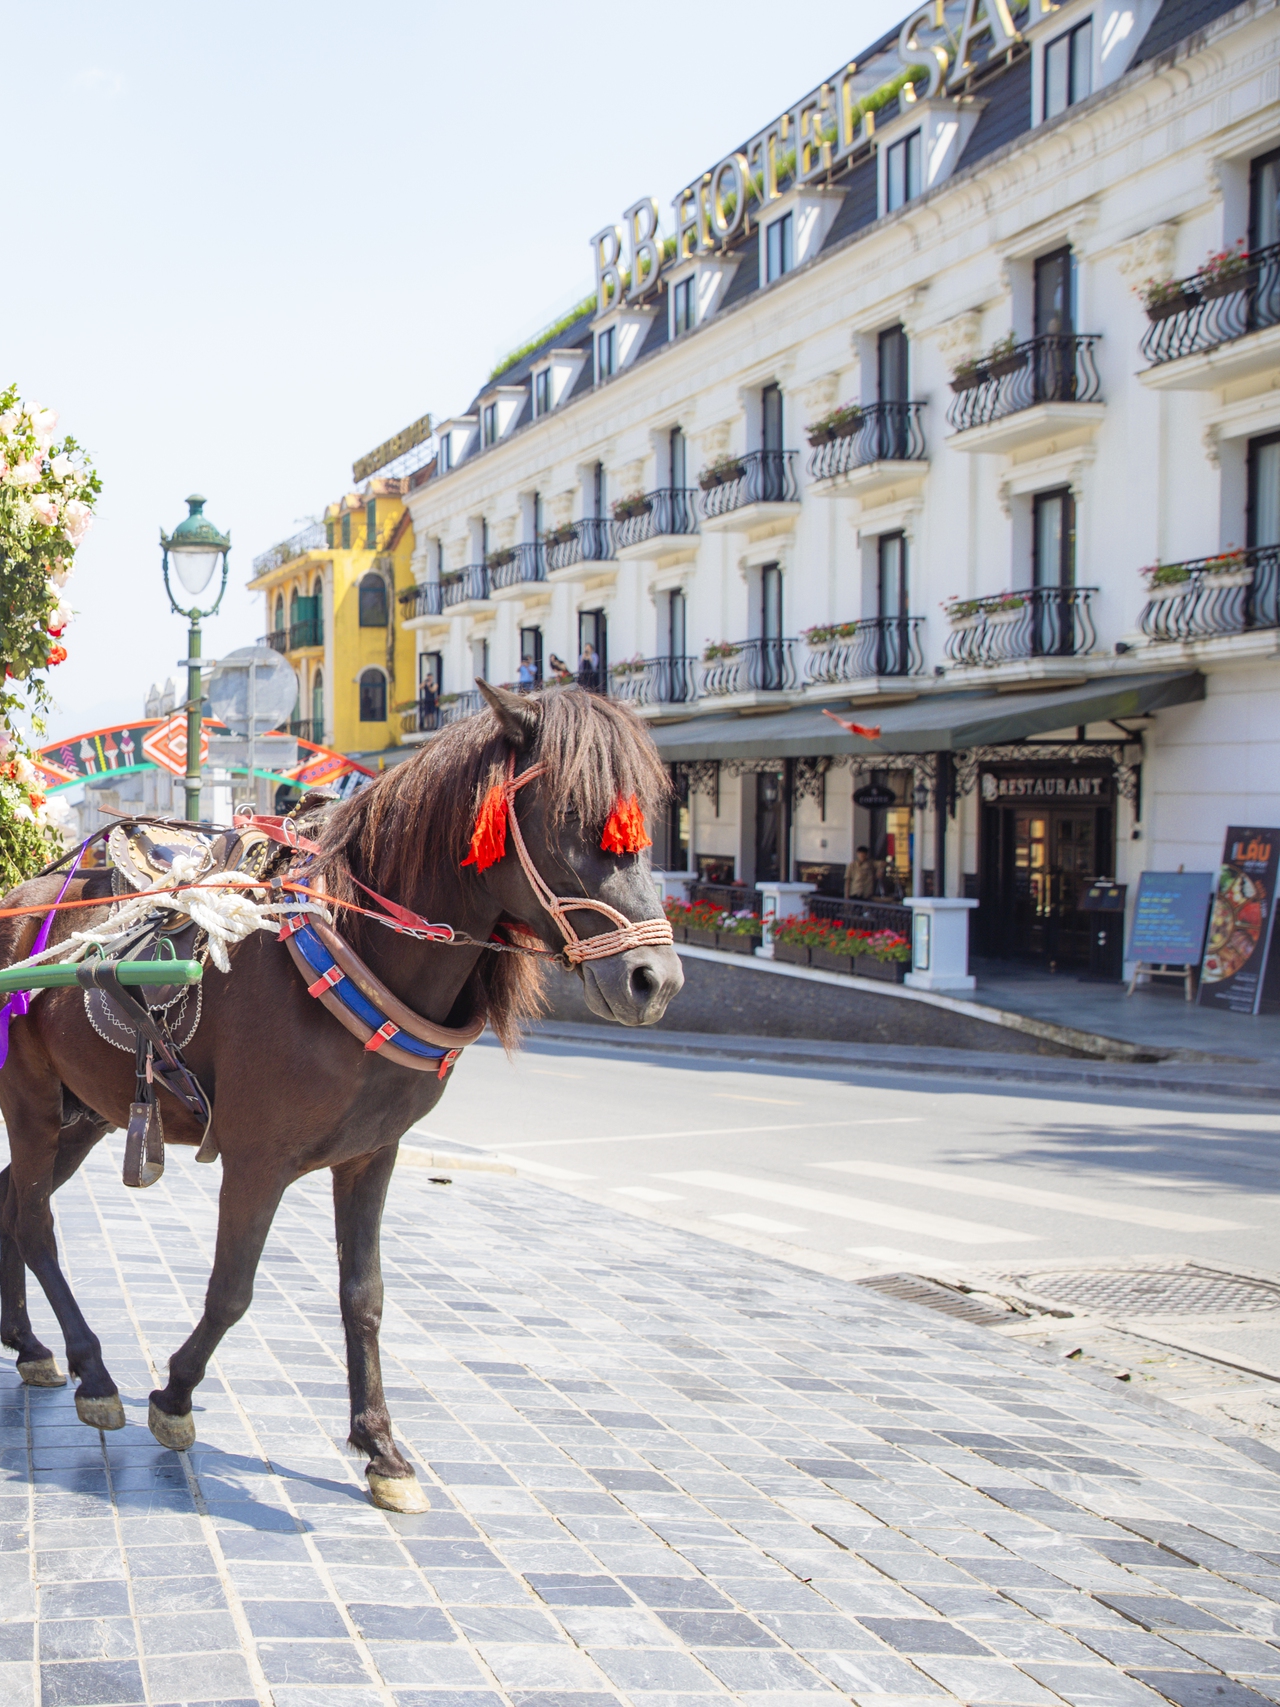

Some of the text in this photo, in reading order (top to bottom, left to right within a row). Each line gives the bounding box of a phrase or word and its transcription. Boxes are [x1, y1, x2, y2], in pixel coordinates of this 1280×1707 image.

[589, 0, 1061, 319] BB HOTEL SA
[999, 778, 1103, 796] RESTAURANT
